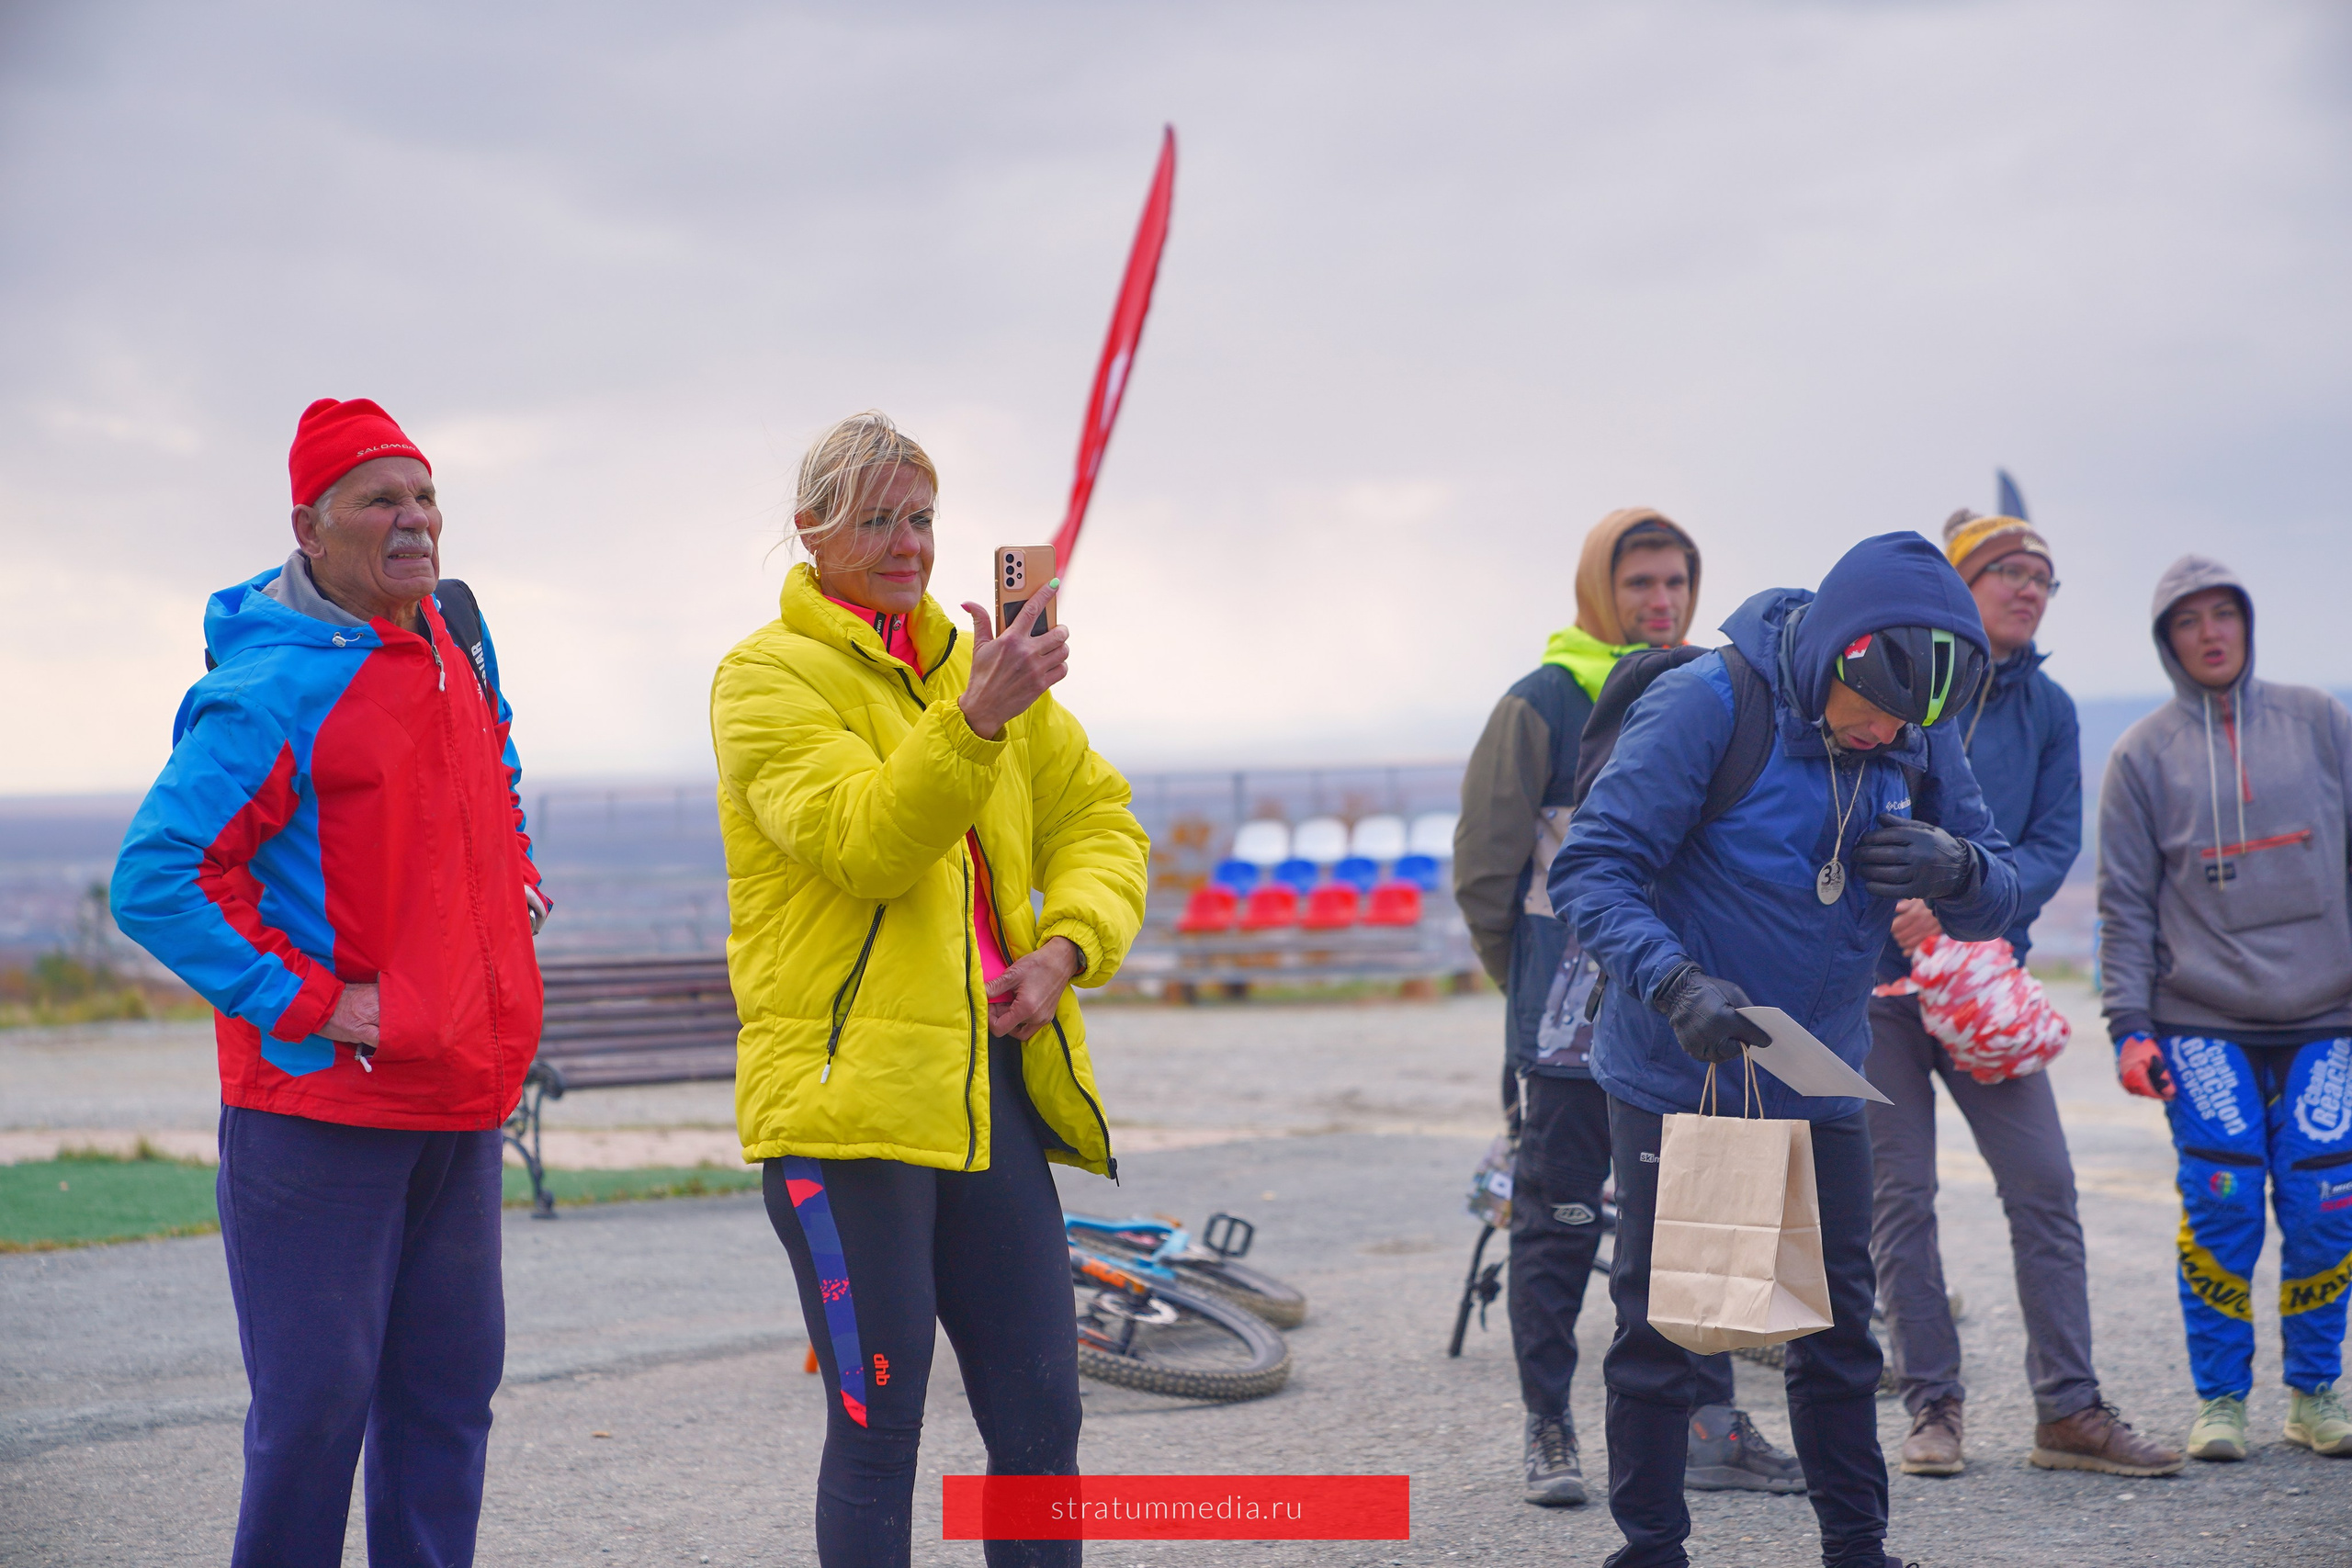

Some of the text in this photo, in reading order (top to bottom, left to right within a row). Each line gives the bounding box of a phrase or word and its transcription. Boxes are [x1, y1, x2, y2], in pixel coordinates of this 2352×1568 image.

[356, 444, 416, 457] SALOMON
[2180, 1036, 2248, 1136] Reaction
[2311, 1037, 2351, 1128] Reactio
[874, 1353, 890, 1385] dhb
